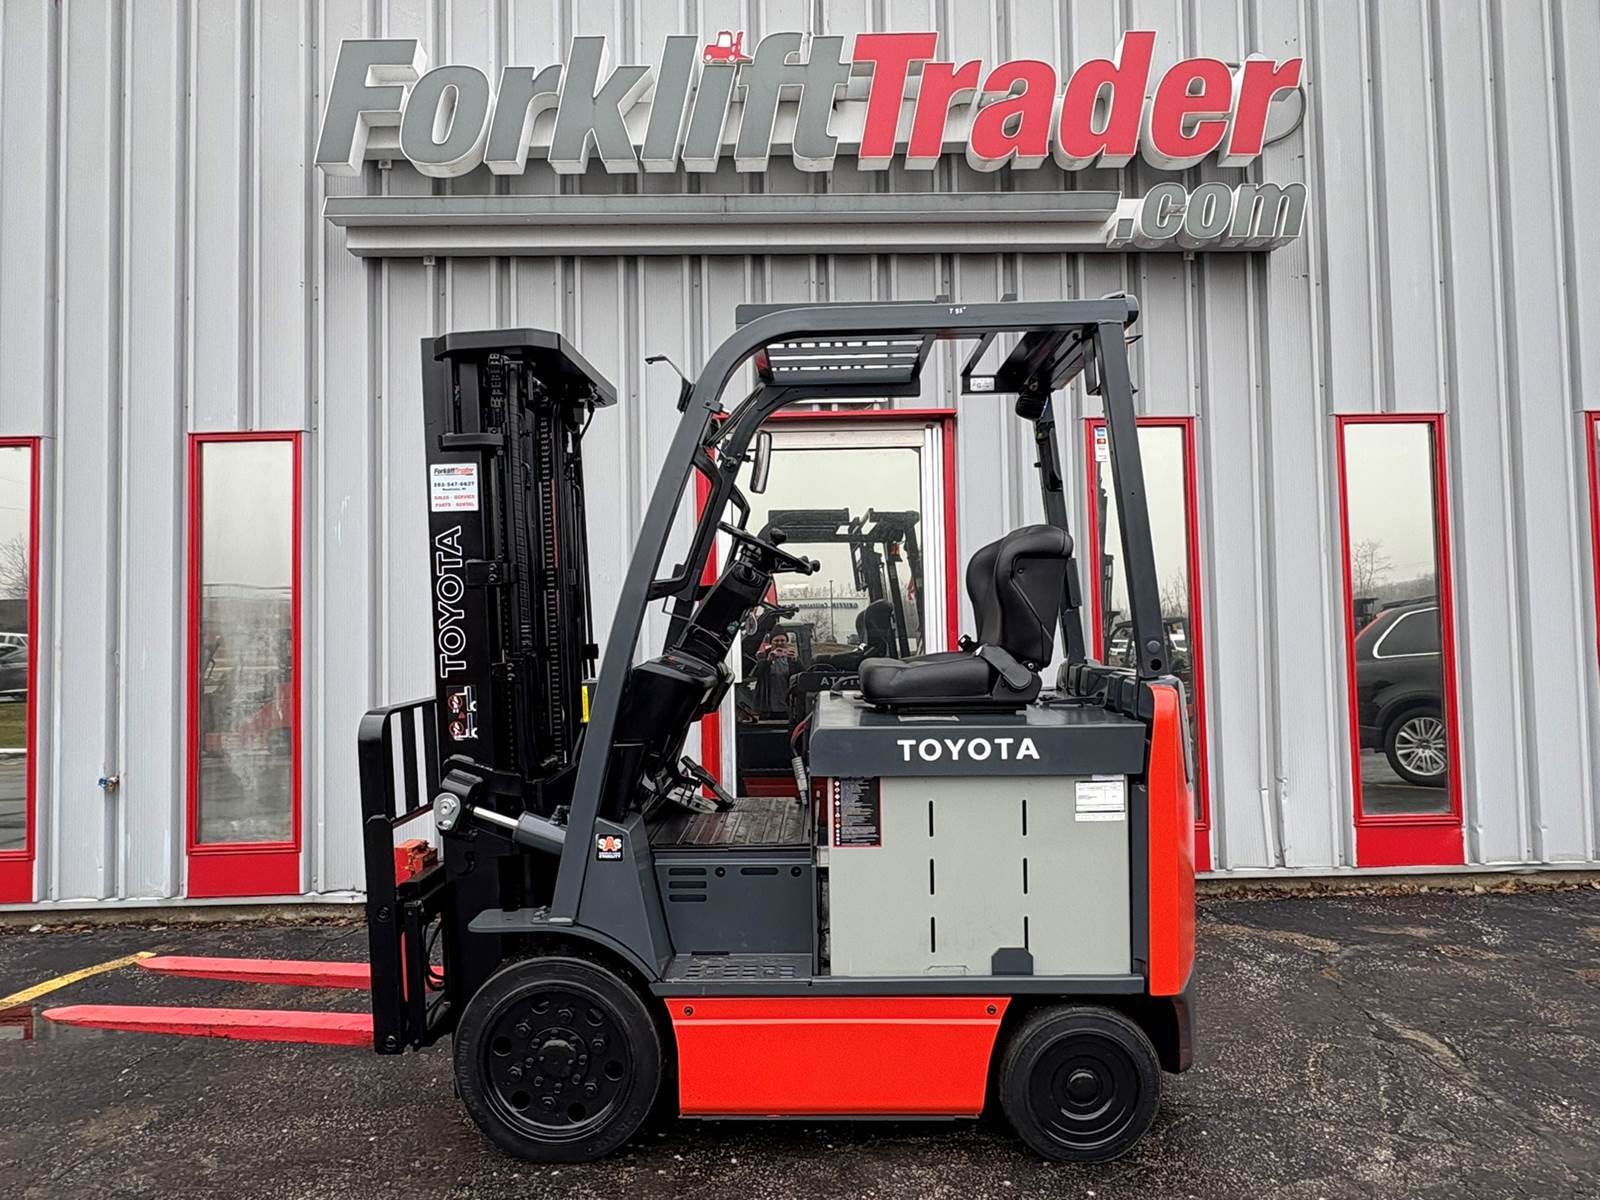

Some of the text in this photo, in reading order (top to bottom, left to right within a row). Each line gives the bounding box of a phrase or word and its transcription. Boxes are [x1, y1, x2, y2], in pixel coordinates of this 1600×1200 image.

[313, 31, 1304, 166] ForkliftTrader
[1114, 182, 1308, 240] .com
[435, 525, 466, 678] TOYOTA
[896, 737, 1040, 762] TOYOTA
[598, 836, 622, 851] SAS
